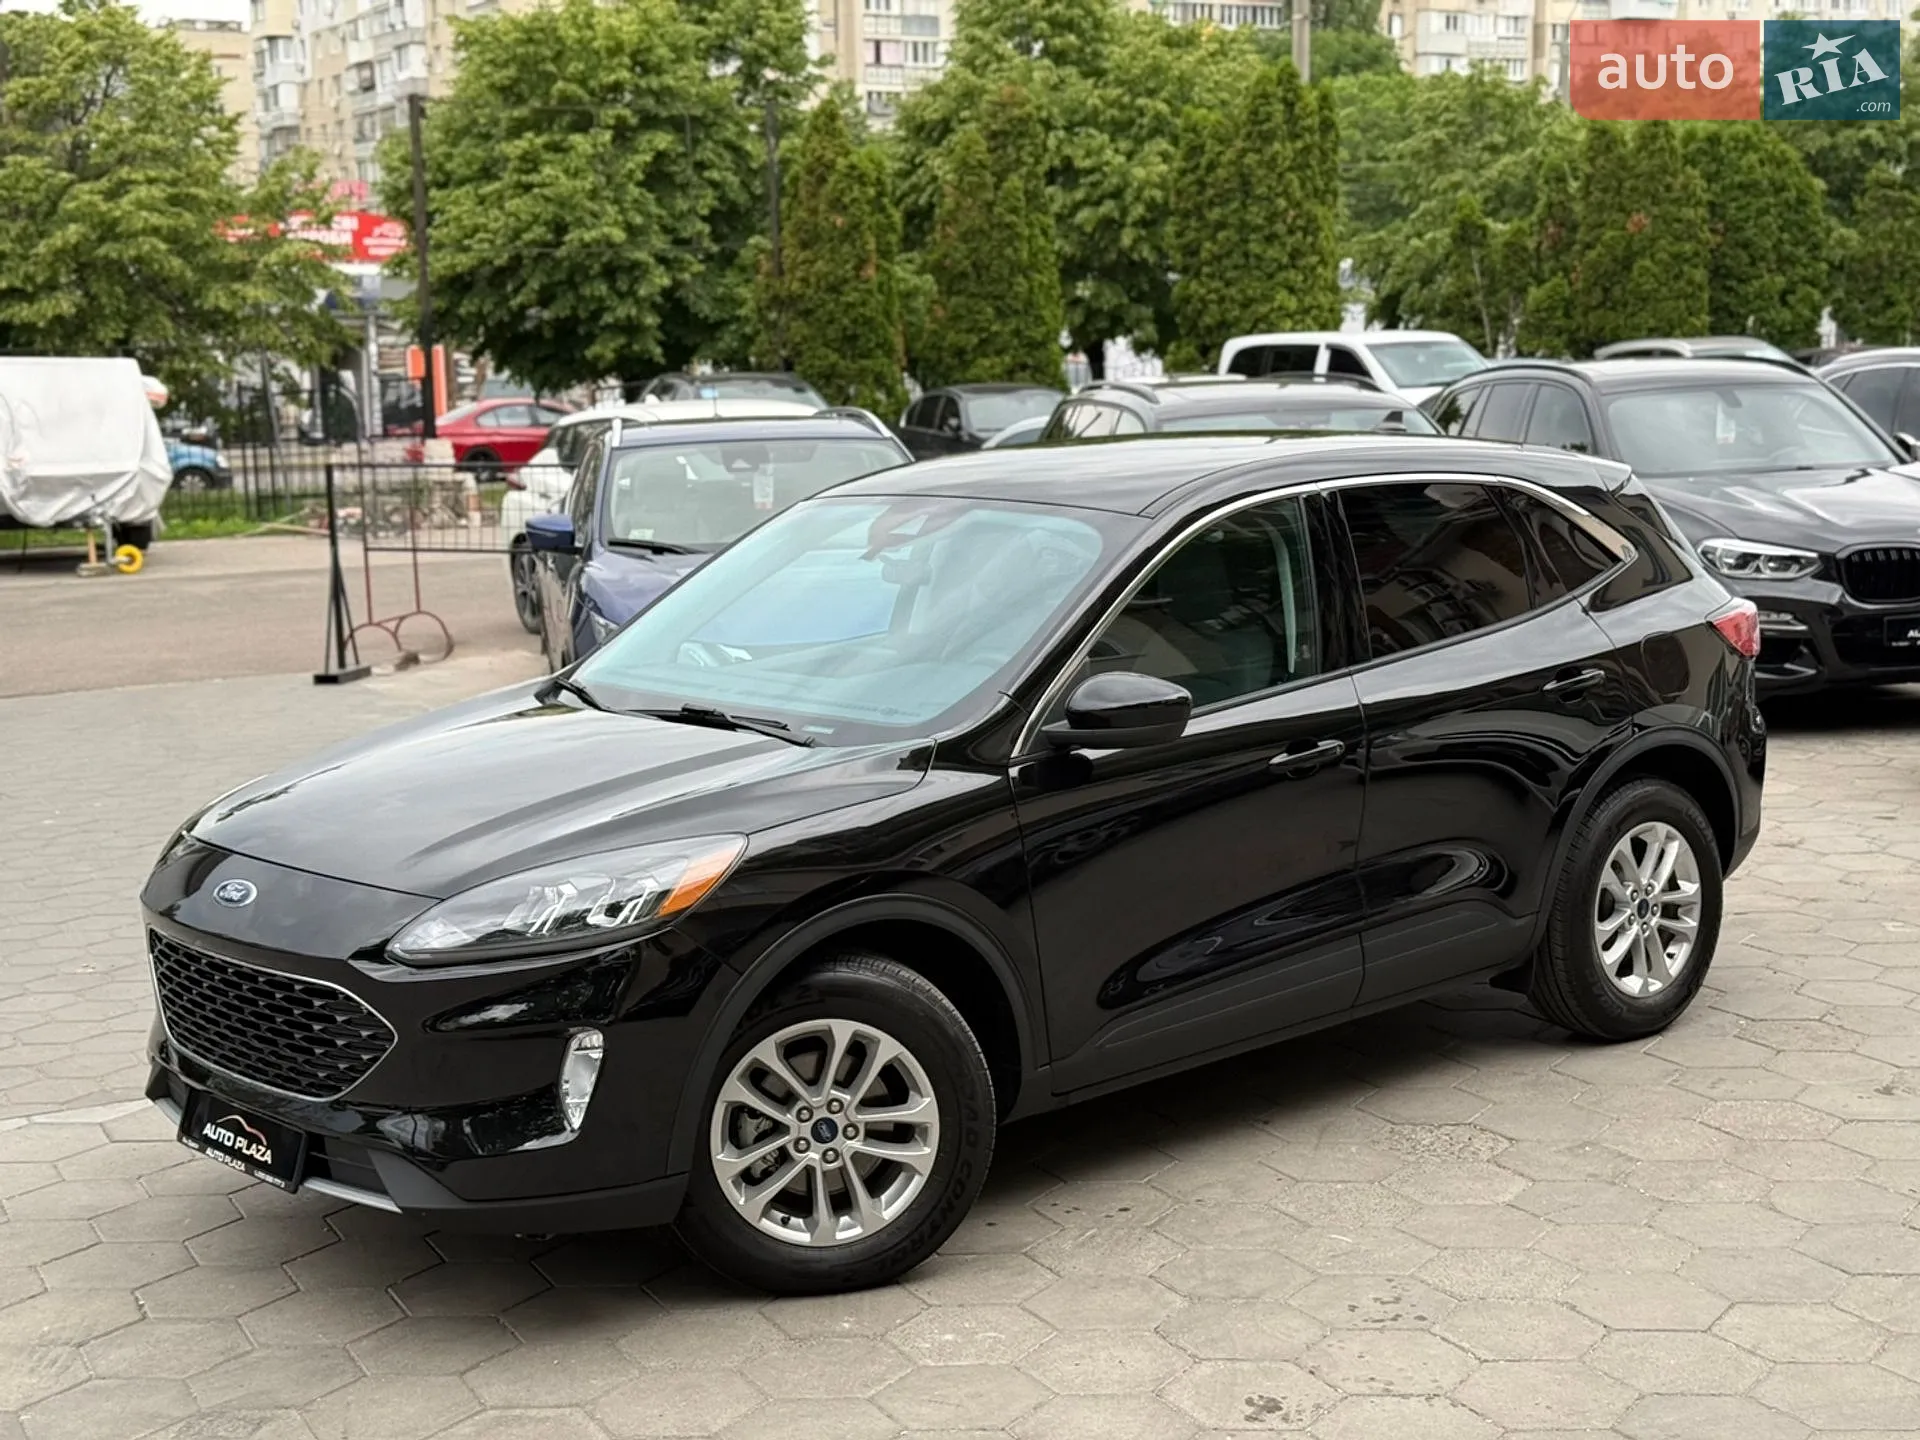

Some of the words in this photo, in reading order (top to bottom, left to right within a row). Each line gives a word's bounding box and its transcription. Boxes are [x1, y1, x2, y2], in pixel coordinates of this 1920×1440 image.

[202, 1122, 234, 1147] AUTO
[234, 1136, 272, 1165] PLAZA
[205, 1147, 225, 1163] AUTO
[224, 1155, 246, 1171] PLAZA
